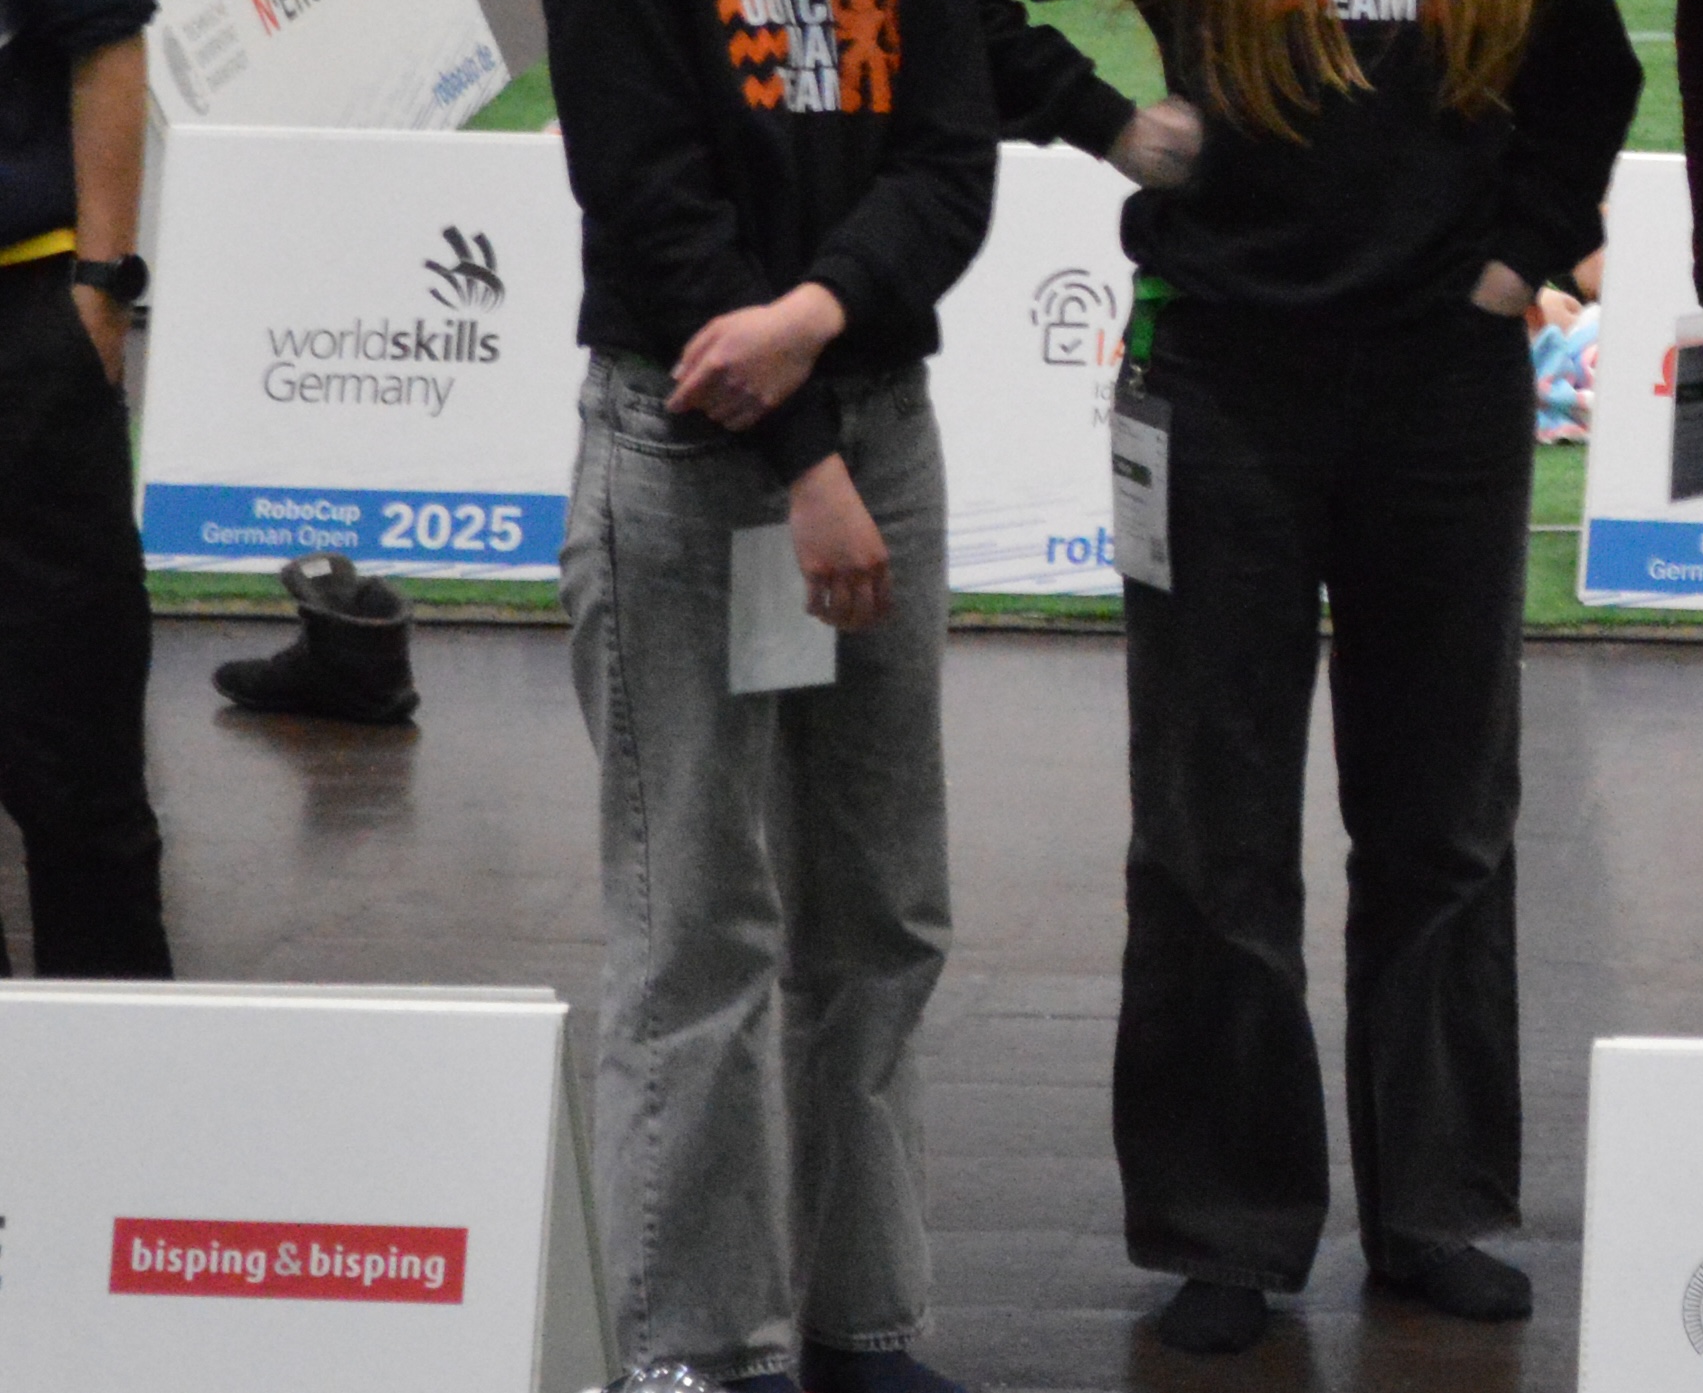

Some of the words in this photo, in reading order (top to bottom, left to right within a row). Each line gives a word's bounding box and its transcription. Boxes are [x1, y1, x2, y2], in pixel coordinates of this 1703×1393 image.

[267, 318, 501, 363] worldskills
[264, 360, 456, 418] Germany
[254, 497, 362, 525] RoboCup
[380, 502, 524, 552] 2025
[202, 520, 293, 547] German
[299, 525, 359, 551] Open
[131, 1236, 267, 1284] bisping
[274, 1240, 302, 1276] &
[309, 1242, 447, 1290] bisping
